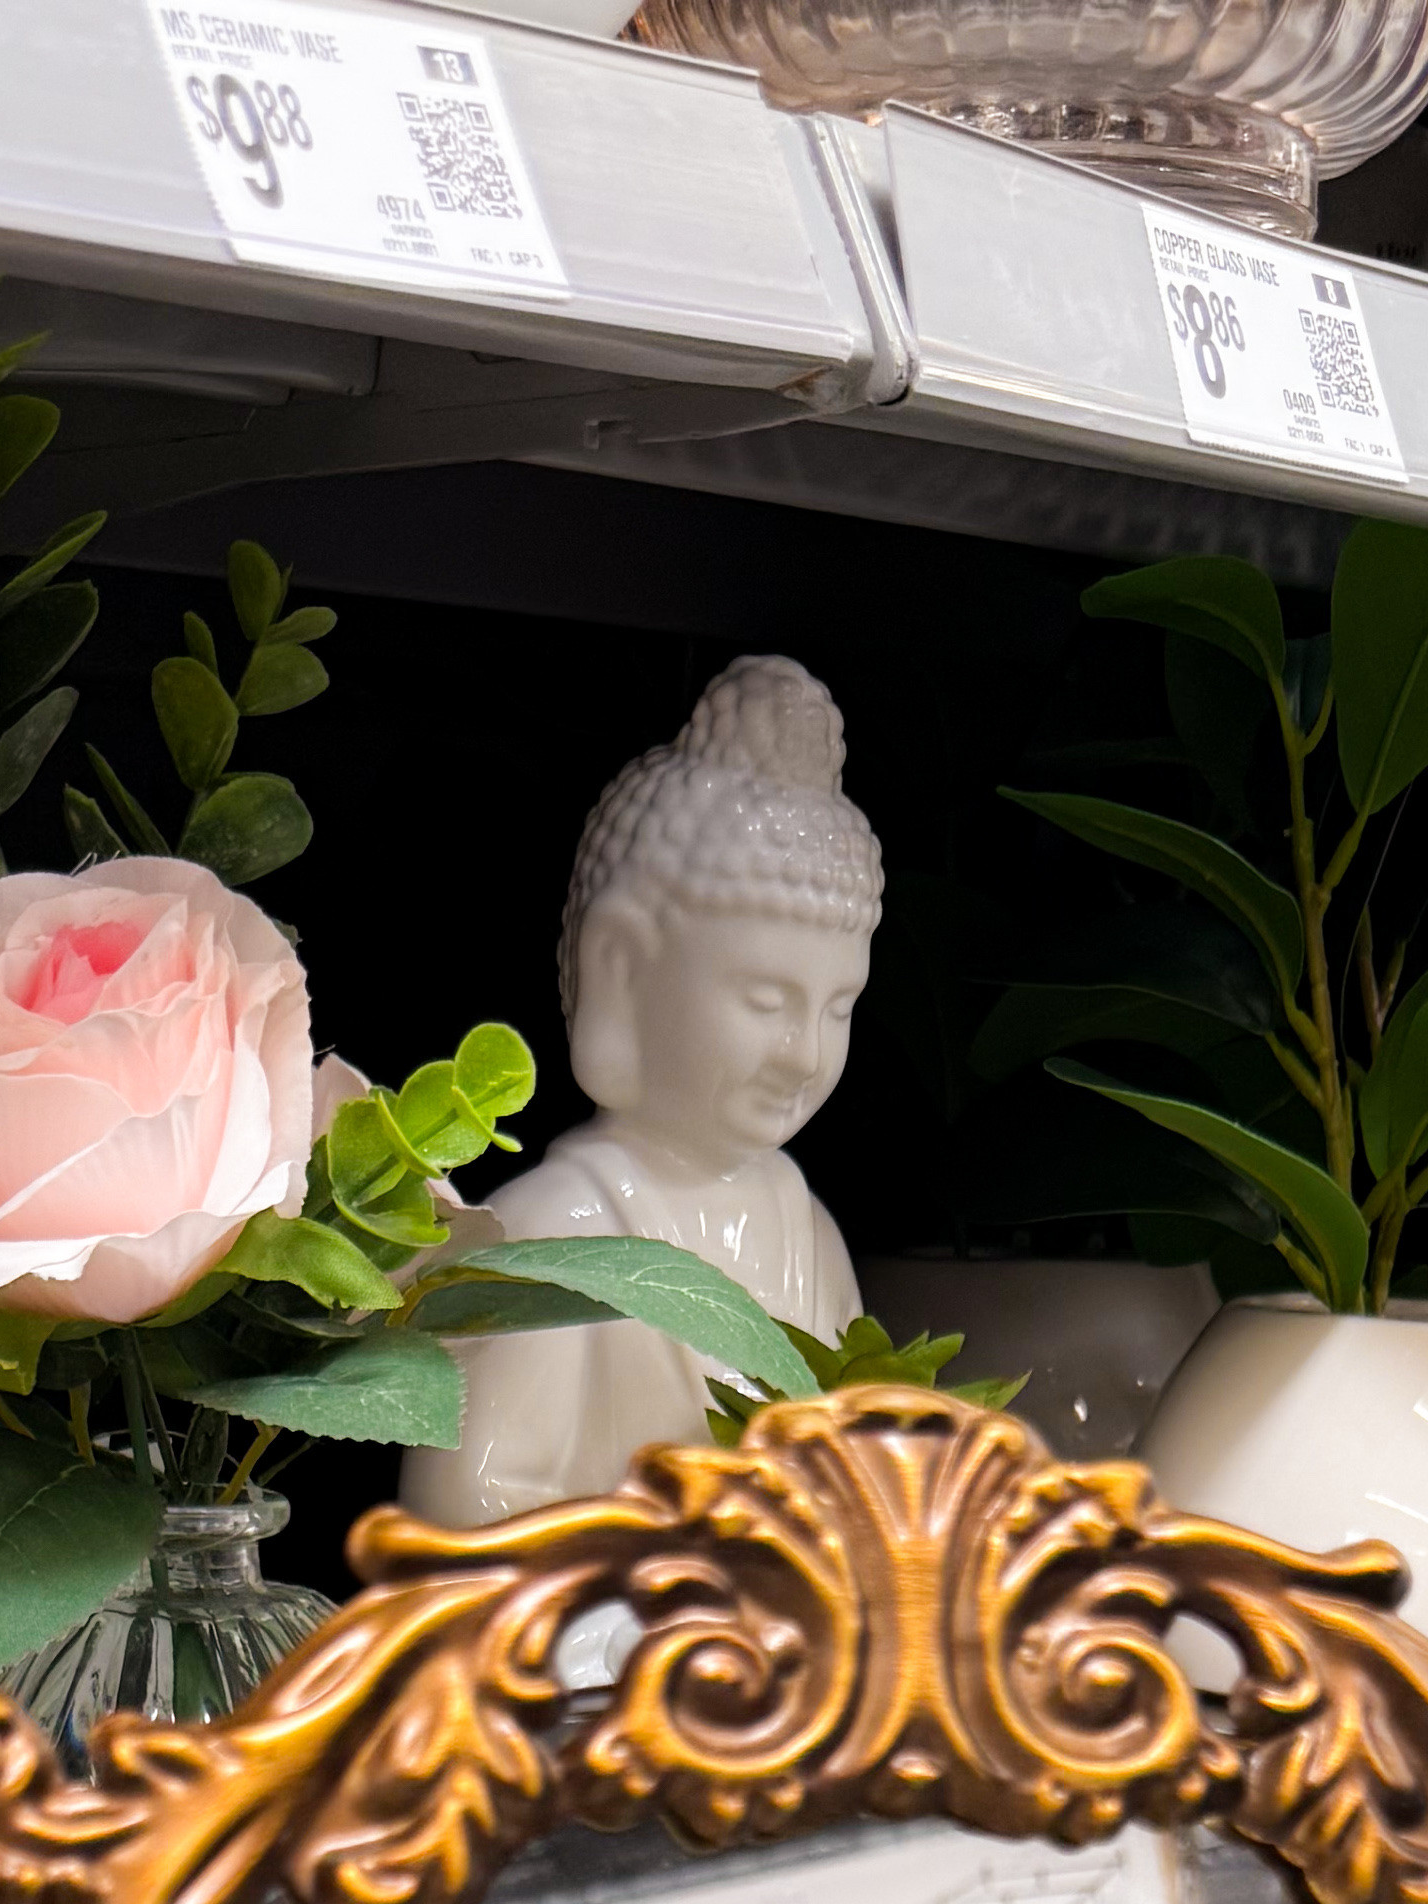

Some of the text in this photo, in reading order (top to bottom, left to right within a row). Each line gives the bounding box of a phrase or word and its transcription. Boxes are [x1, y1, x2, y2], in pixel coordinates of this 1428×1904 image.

[161, 8, 344, 65] MS CERAMIC VASE
[432, 51, 465, 82] 13
[377, 195, 426, 221] 4974
[1153, 227, 1280, 287] COPPER GLASS VASE
[1325, 280, 1338, 303] 8
[1283, 389, 1316, 415] 0409
